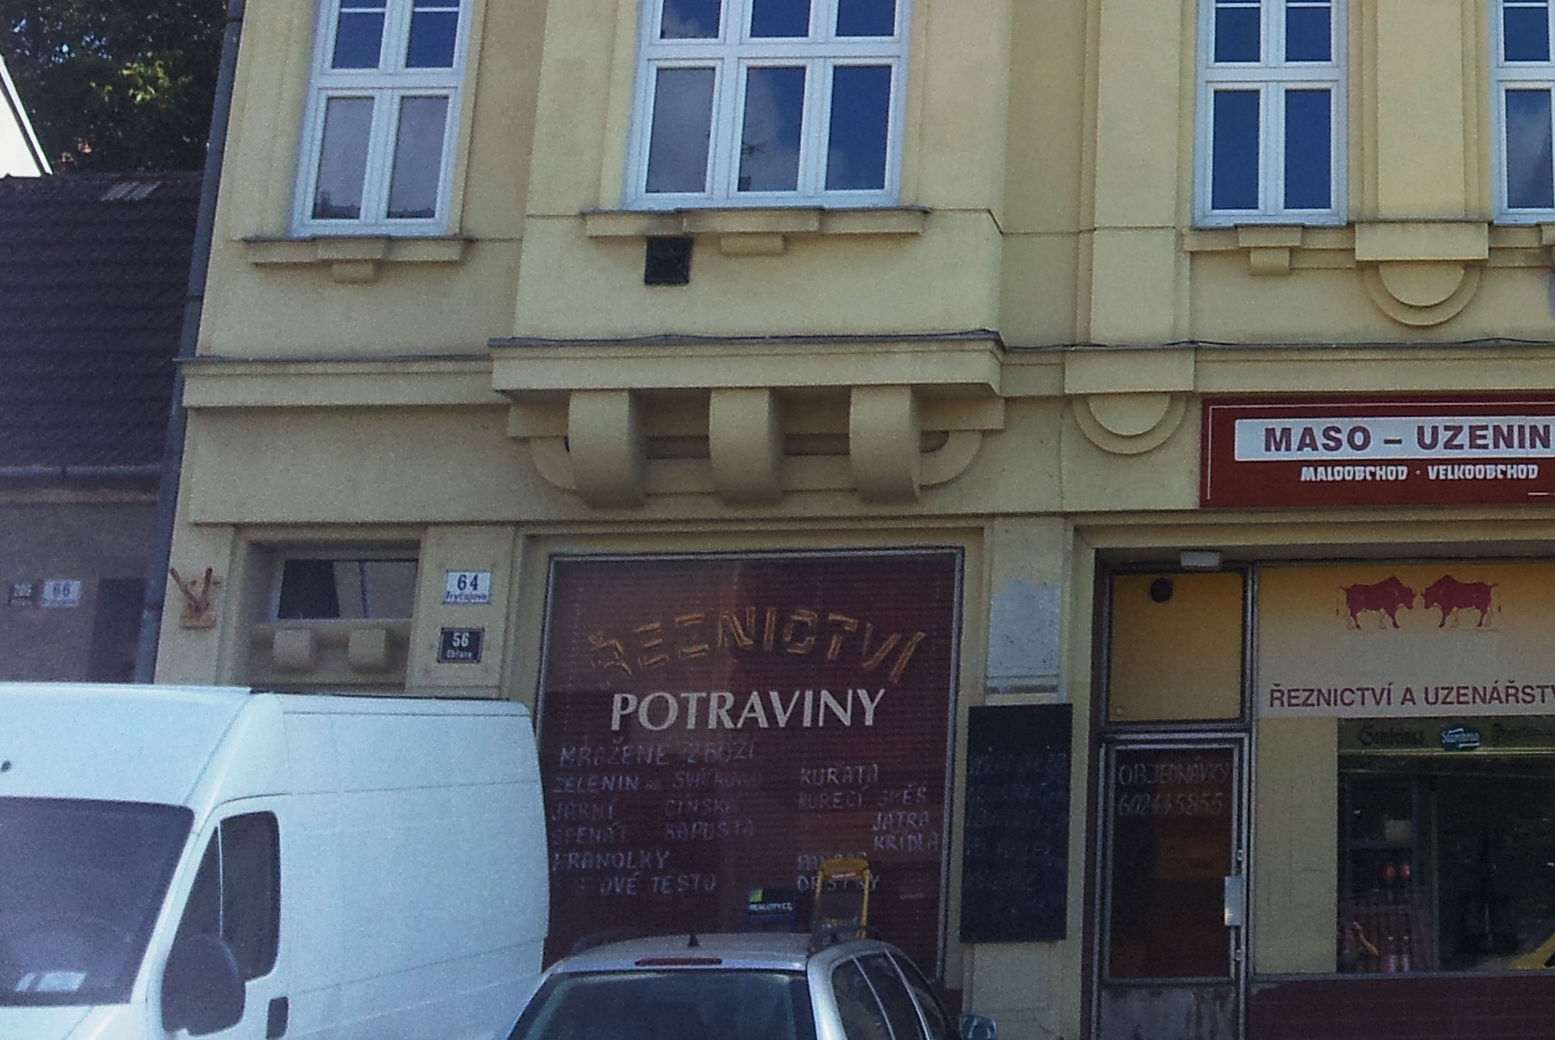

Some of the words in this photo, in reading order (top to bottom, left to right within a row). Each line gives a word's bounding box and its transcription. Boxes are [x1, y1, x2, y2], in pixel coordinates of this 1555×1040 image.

[1263, 425, 1372, 453] MASO
[1300, 465, 1409, 482] MALOOBCHOD
[1427, 463, 1539, 480] VELKOOBCHOD
[456, 574, 479, 591] 64
[452, 632, 470, 647] 56
[1269, 682, 1394, 707] ŘEZNICTVÍ
[1400, 686, 1418, 706] A
[610, 688, 886, 731] POTRAVINY
